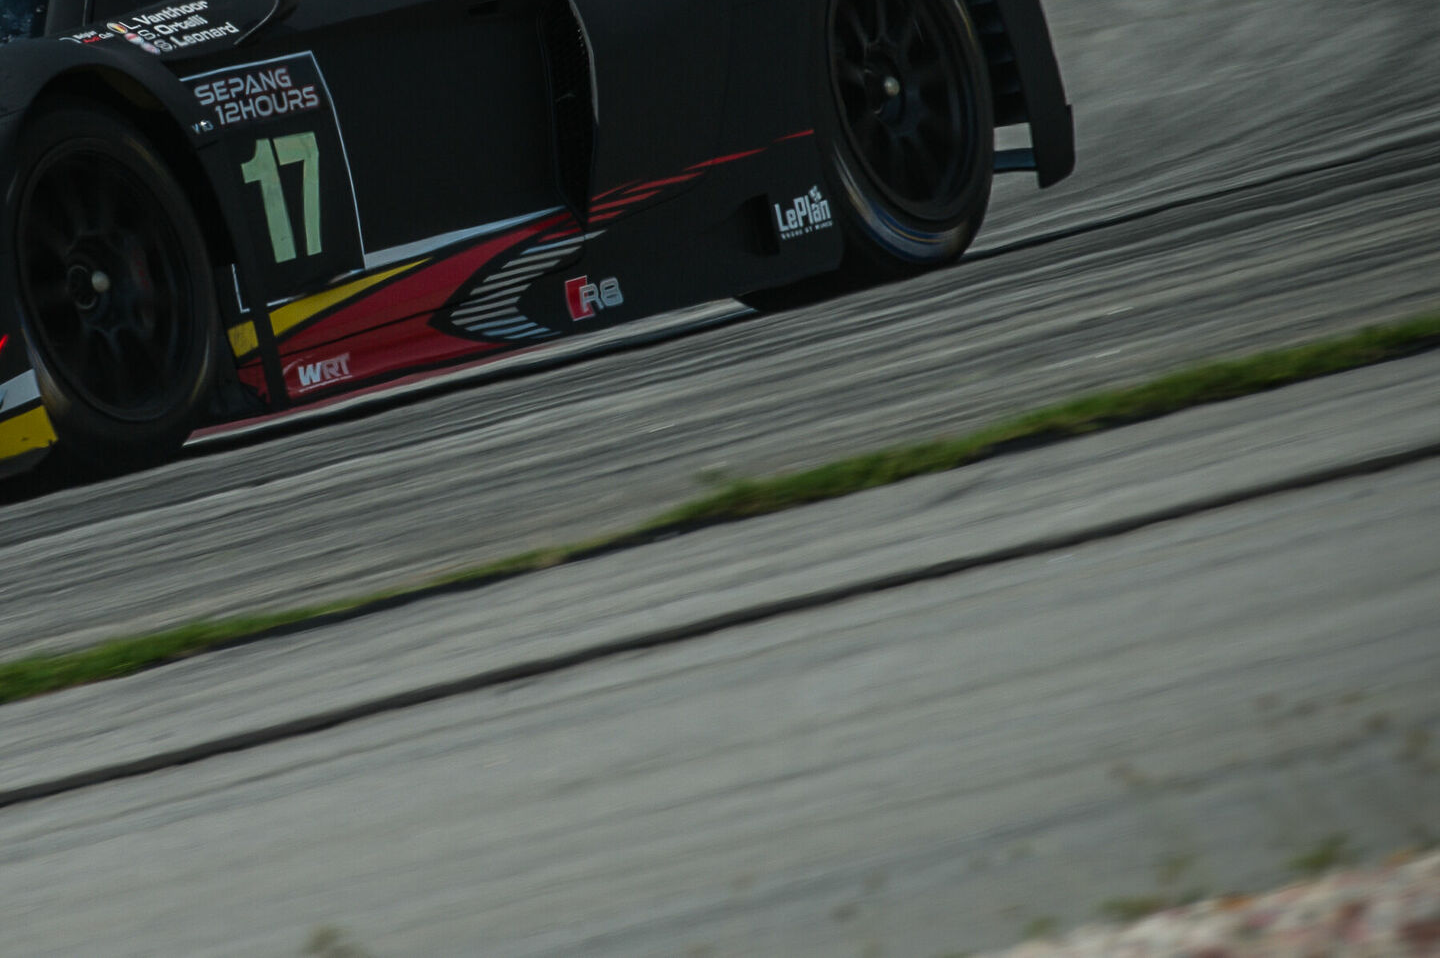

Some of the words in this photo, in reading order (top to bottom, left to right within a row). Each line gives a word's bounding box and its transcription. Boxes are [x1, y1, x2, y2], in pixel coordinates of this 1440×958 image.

[193, 67, 292, 106] SEPANG
[215, 85, 320, 125] 12HOURS
[241, 130, 321, 264] 17
[774, 195, 832, 232] LePlan
[576, 276, 625, 315] R8
[297, 353, 351, 387] WRT
